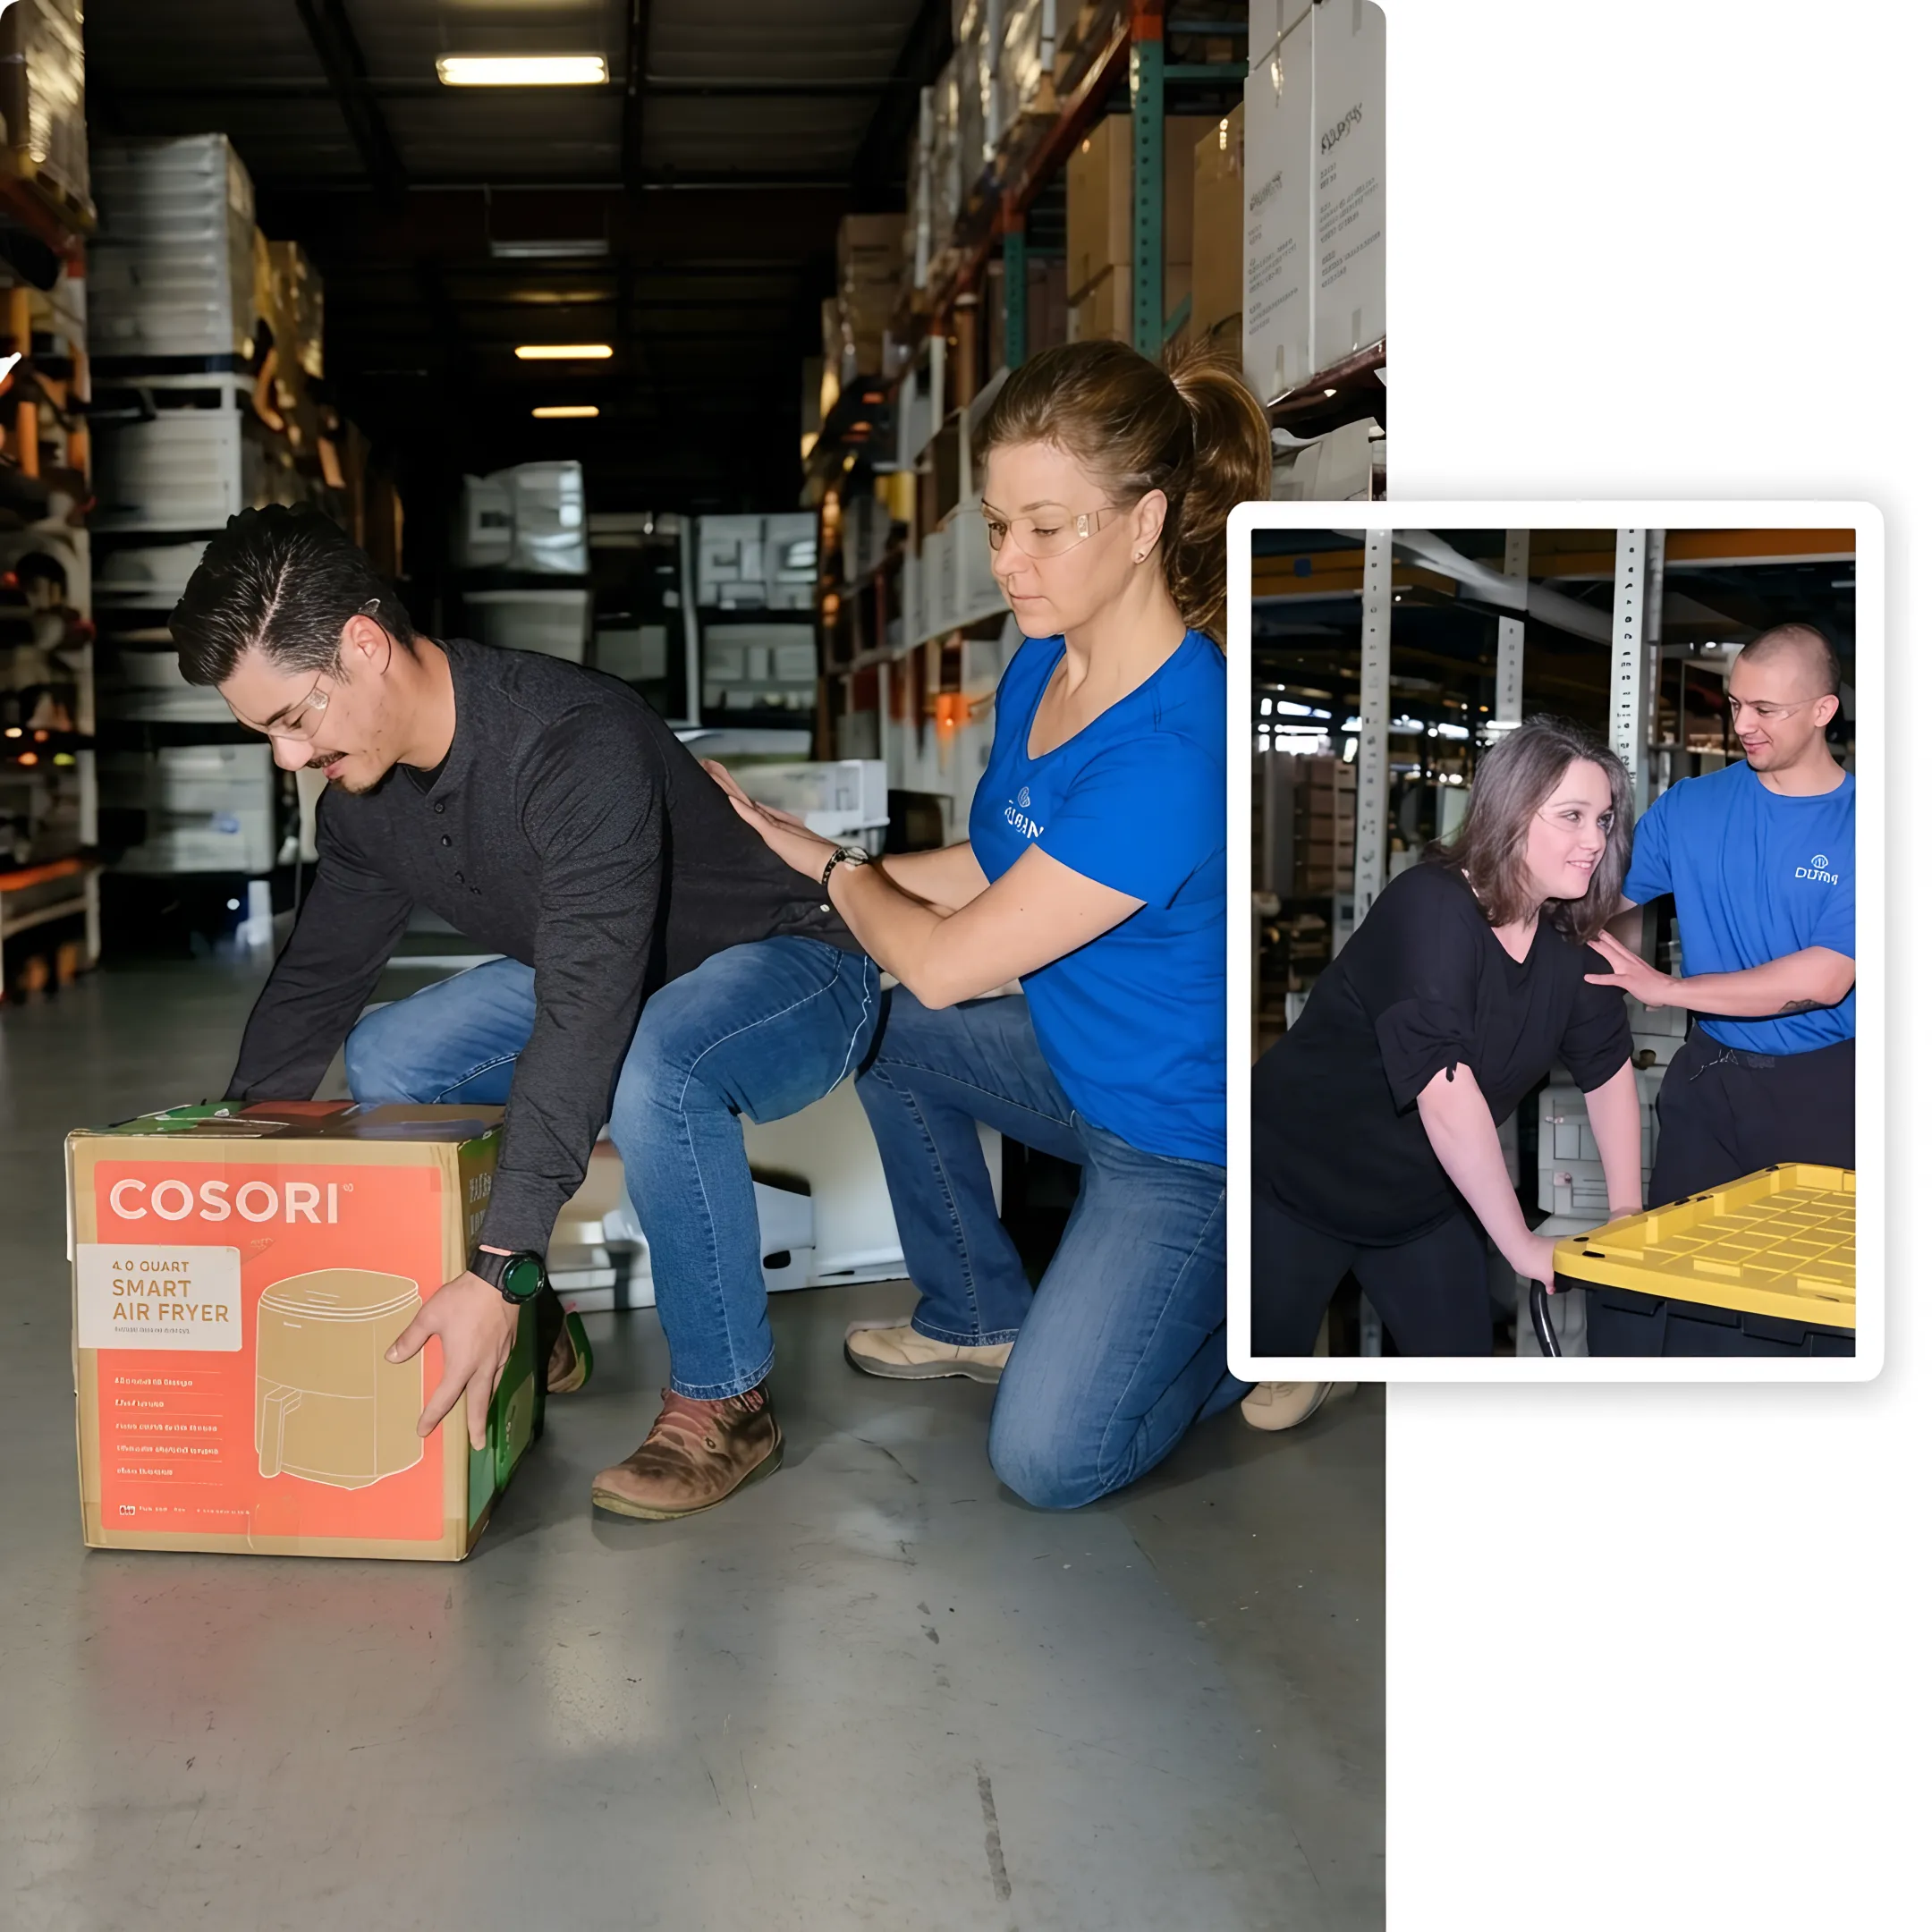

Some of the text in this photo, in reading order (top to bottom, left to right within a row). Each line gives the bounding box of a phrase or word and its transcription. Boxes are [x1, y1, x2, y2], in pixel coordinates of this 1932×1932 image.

[109, 1178, 338, 1224] COSORI
[112, 1278, 191, 1298] SMART
[113, 1301, 230, 1323] AIR FRYER
